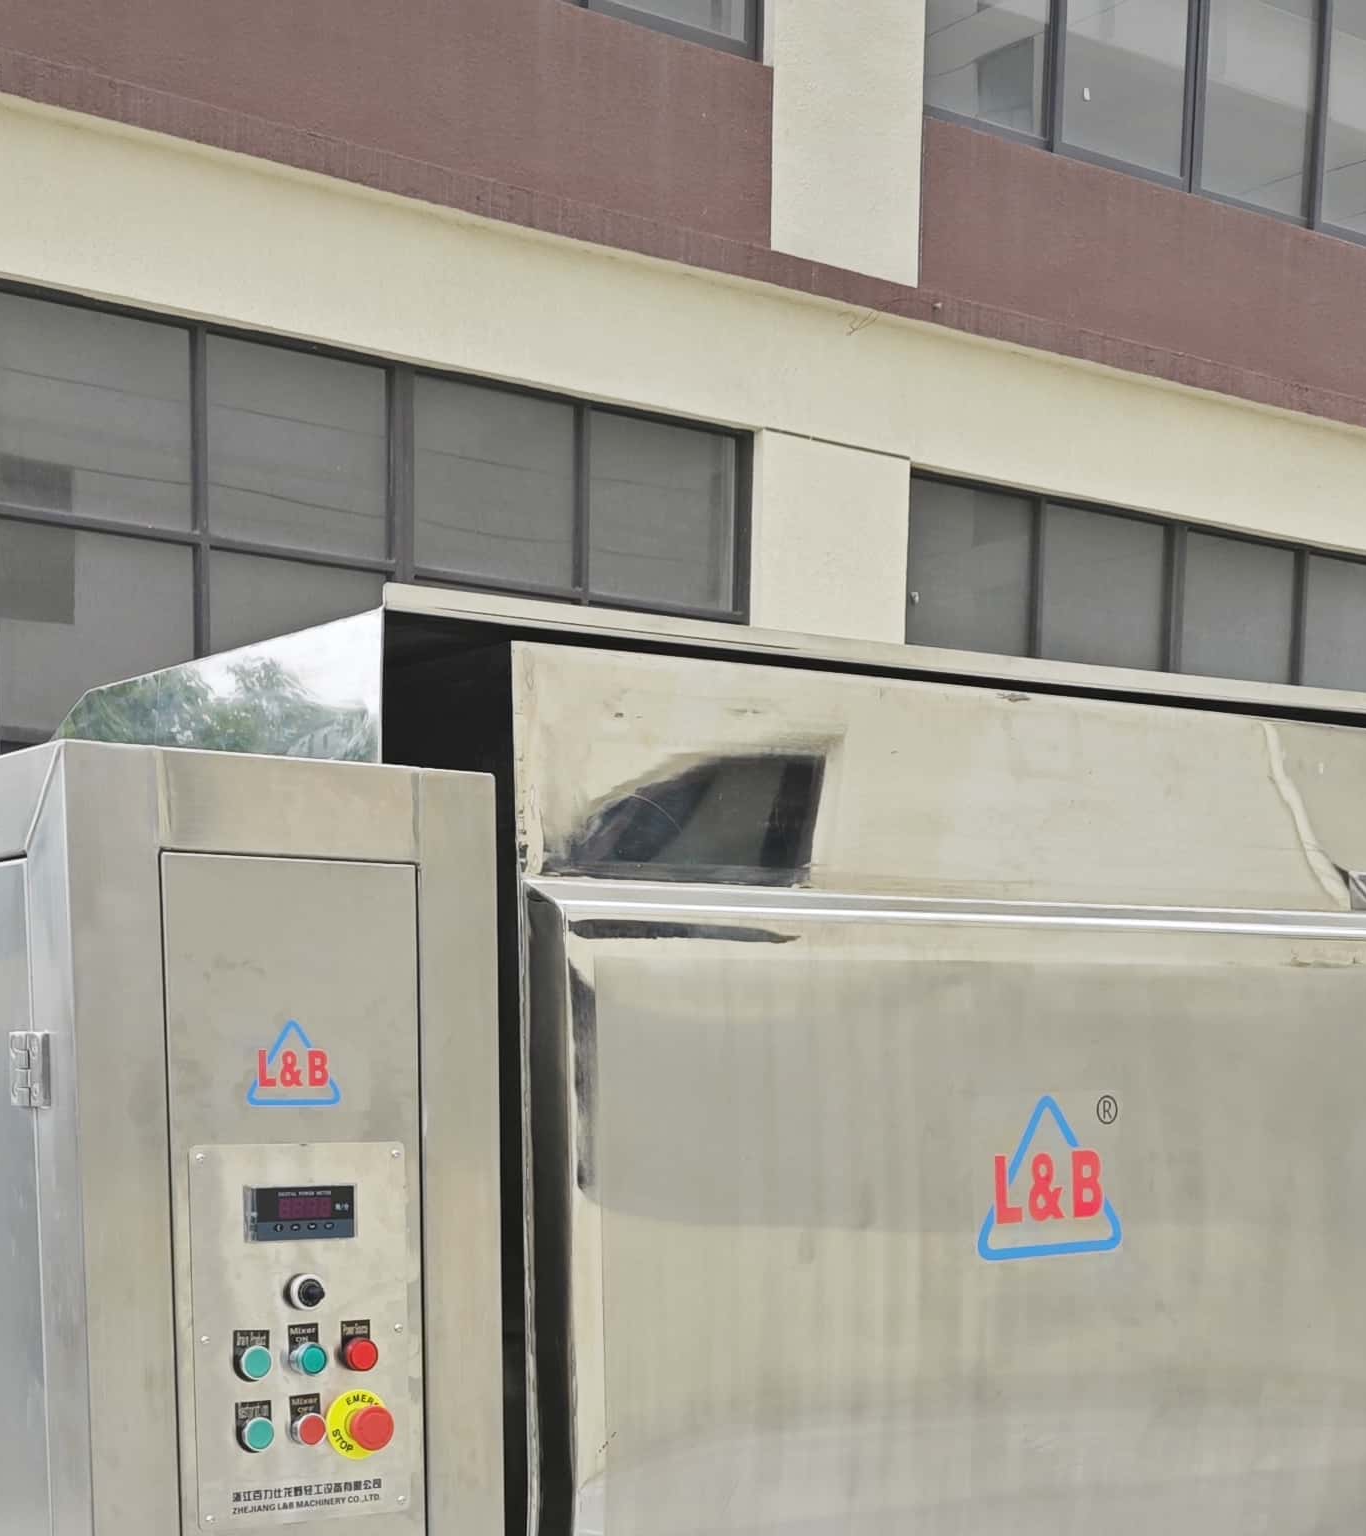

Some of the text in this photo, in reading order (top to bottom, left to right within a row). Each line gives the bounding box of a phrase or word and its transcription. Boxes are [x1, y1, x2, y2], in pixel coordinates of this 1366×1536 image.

[258, 1049, 329, 1088] L&B
[994, 1149, 1104, 1225] L&B
[289, 1327, 316, 1335] Mixer
[332, 1428, 354, 1452] STOP
[232, 1502, 276, 1515] ZHEJIANG
[277, 1500, 295, 1511] L&B
[295, 1496, 346, 1509] MACHINERY
